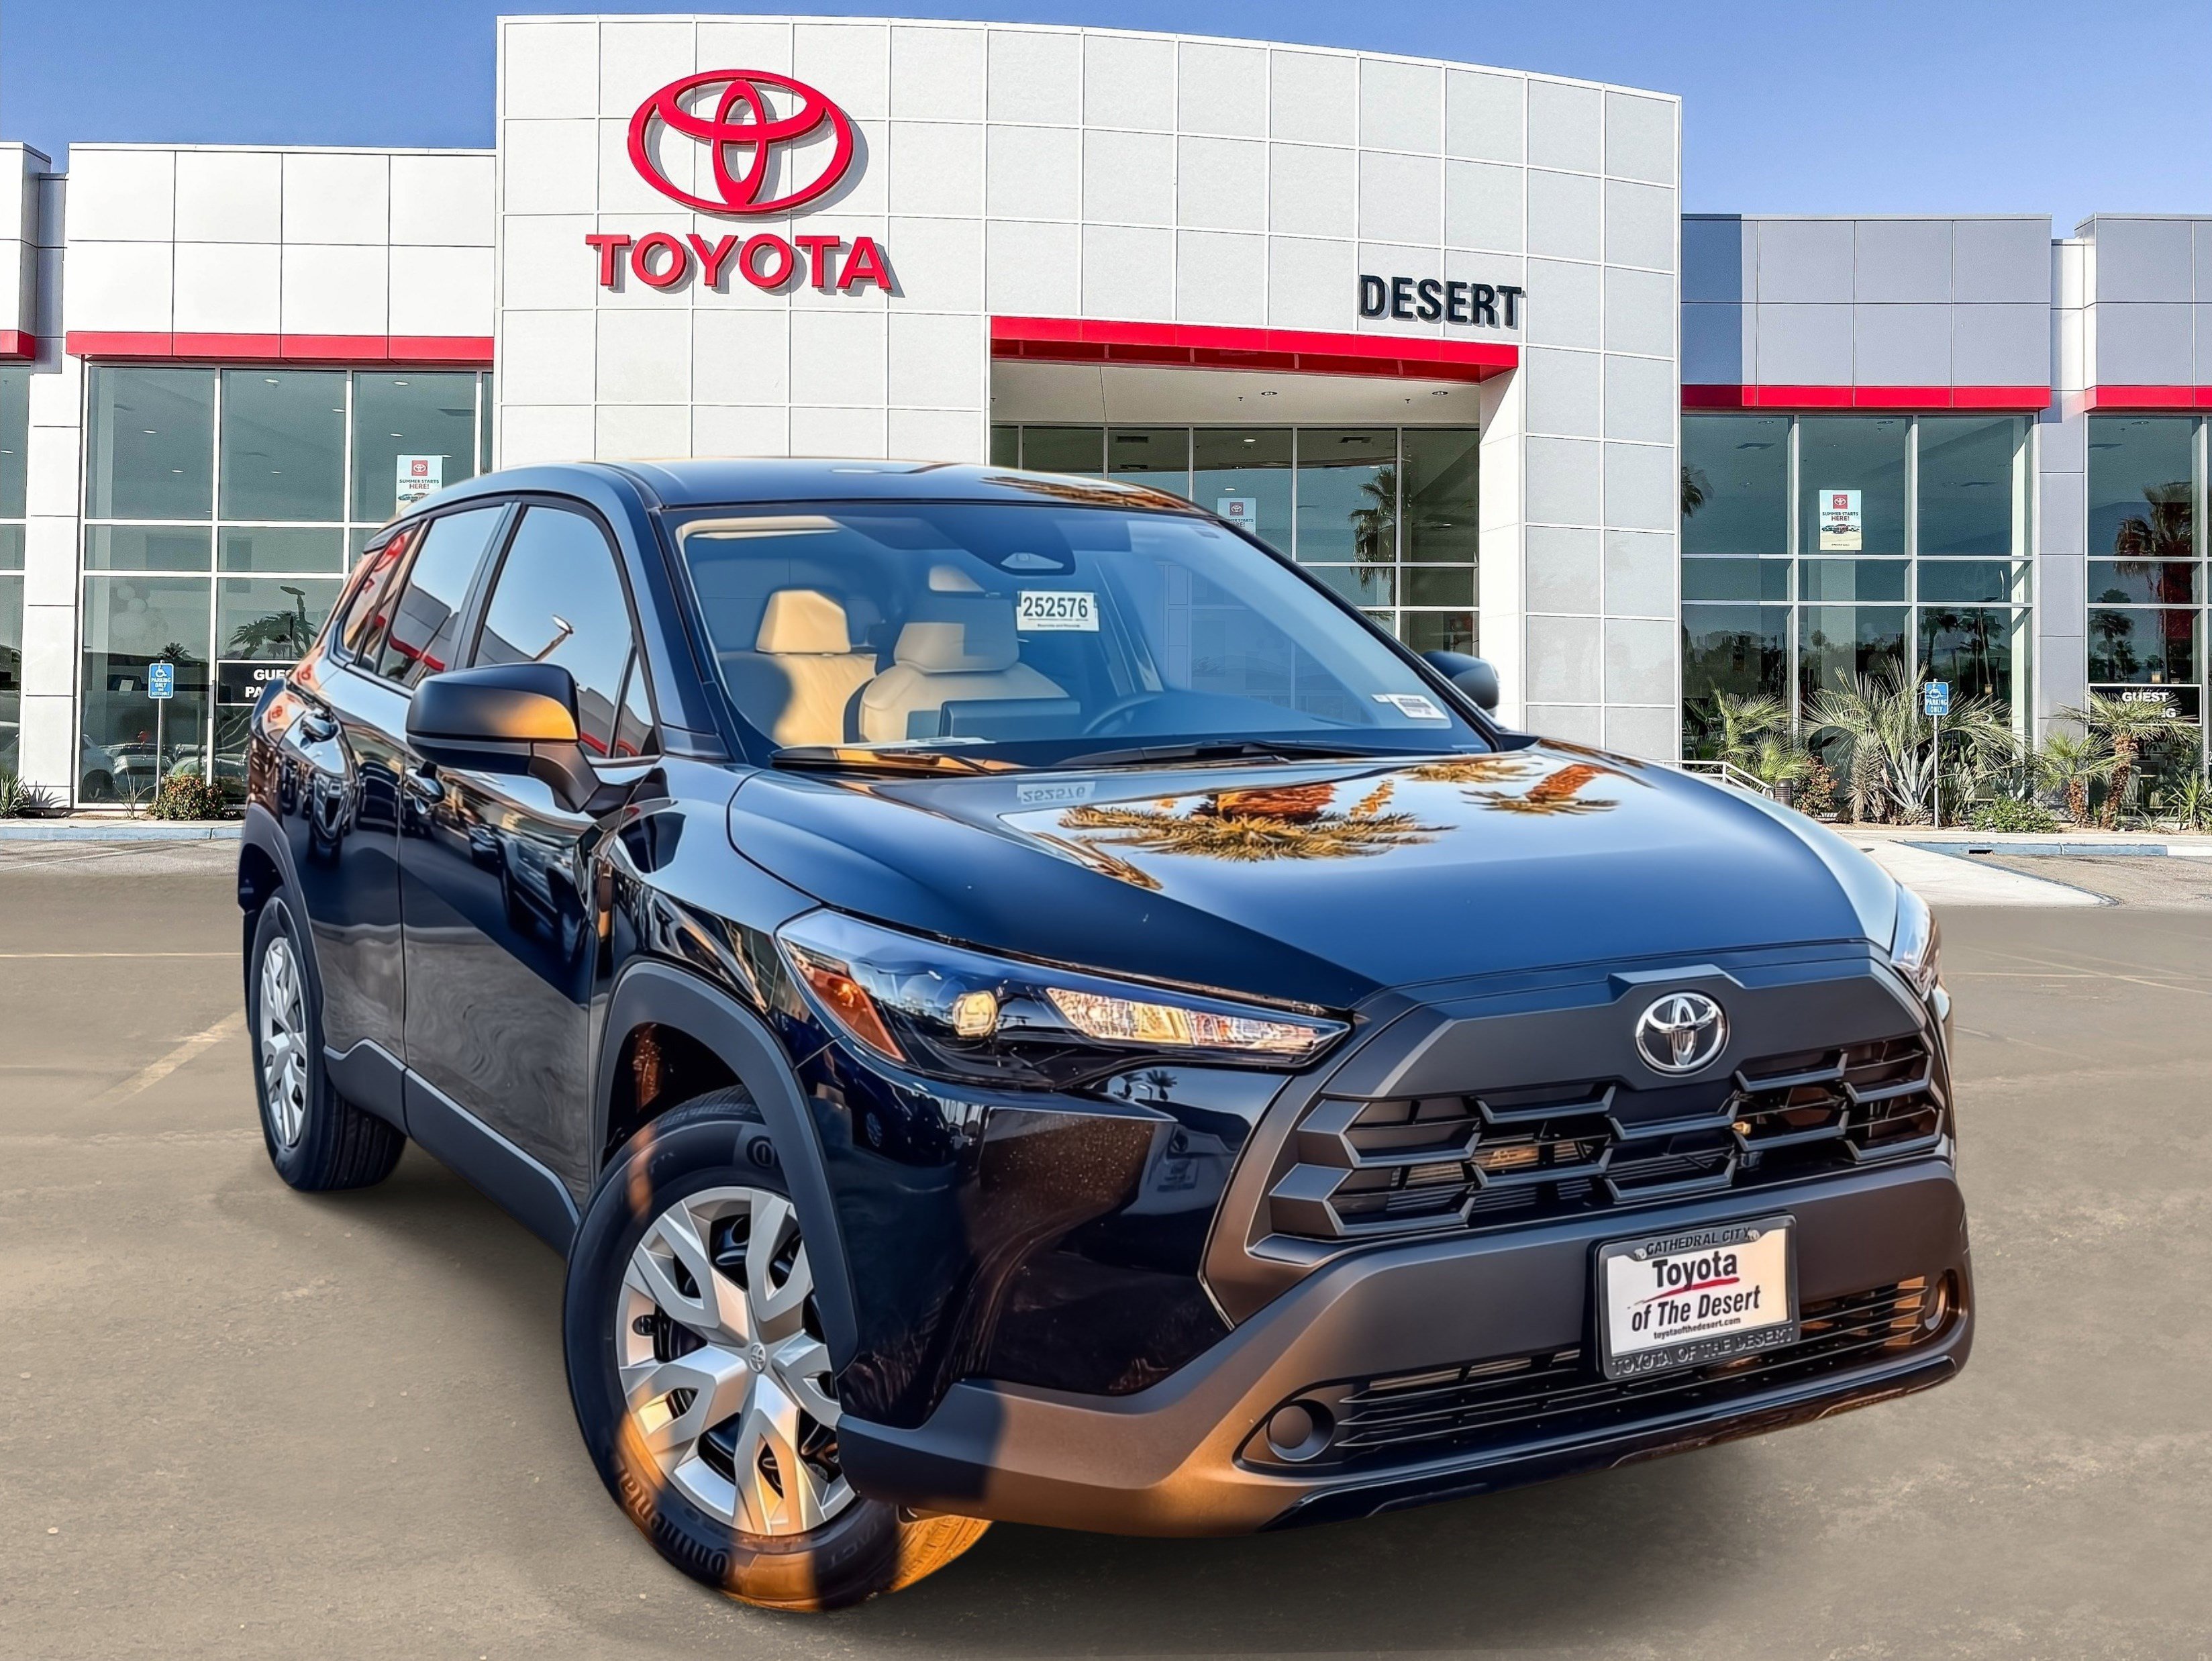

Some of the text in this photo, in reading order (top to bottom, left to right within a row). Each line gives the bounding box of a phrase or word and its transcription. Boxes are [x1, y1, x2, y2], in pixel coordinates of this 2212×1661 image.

[585, 232, 893, 291] TOYOTA
[1358, 274, 1522, 326] DESERT
[1023, 596, 1089, 617] 252576
[2121, 692, 2170, 702] GUEST
[1646, 1227, 1751, 1255] CATHEDRAL CITY
[1652, 1251, 1738, 1291] Toyota
[1631, 1285, 1761, 1331] of The Desert
[1654, 1317, 1741, 1340] toyotaofthedesert.com
[1612, 1327, 1793, 1375] TOYOTA OF THE DESERT
